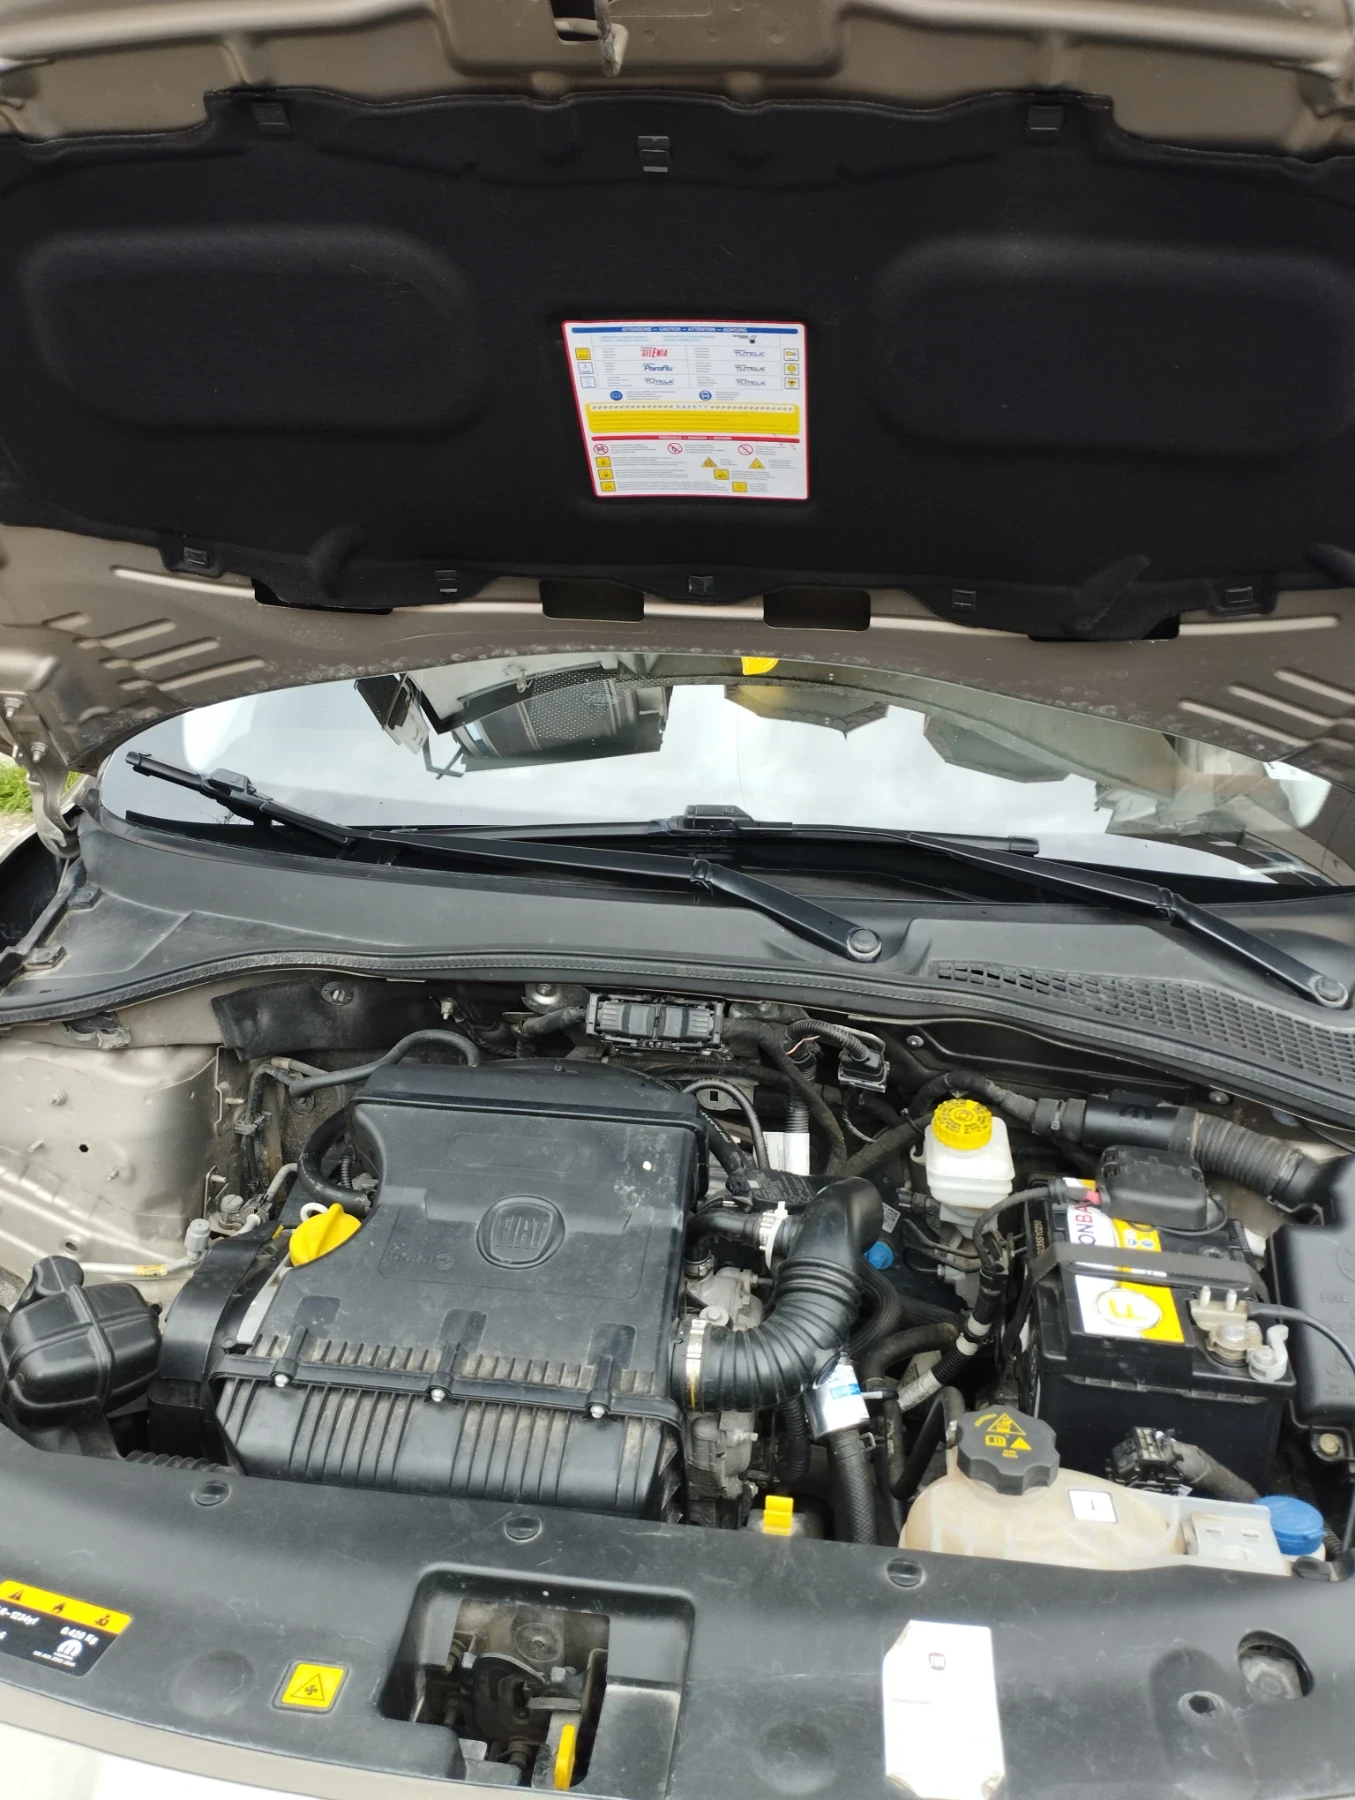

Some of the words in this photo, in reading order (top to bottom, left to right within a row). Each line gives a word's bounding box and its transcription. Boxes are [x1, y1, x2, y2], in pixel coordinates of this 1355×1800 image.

[641, 347, 668, 358] SELENIA
[643, 364, 673, 372] Paraflu
[494, 1215, 550, 1250] FIAT
